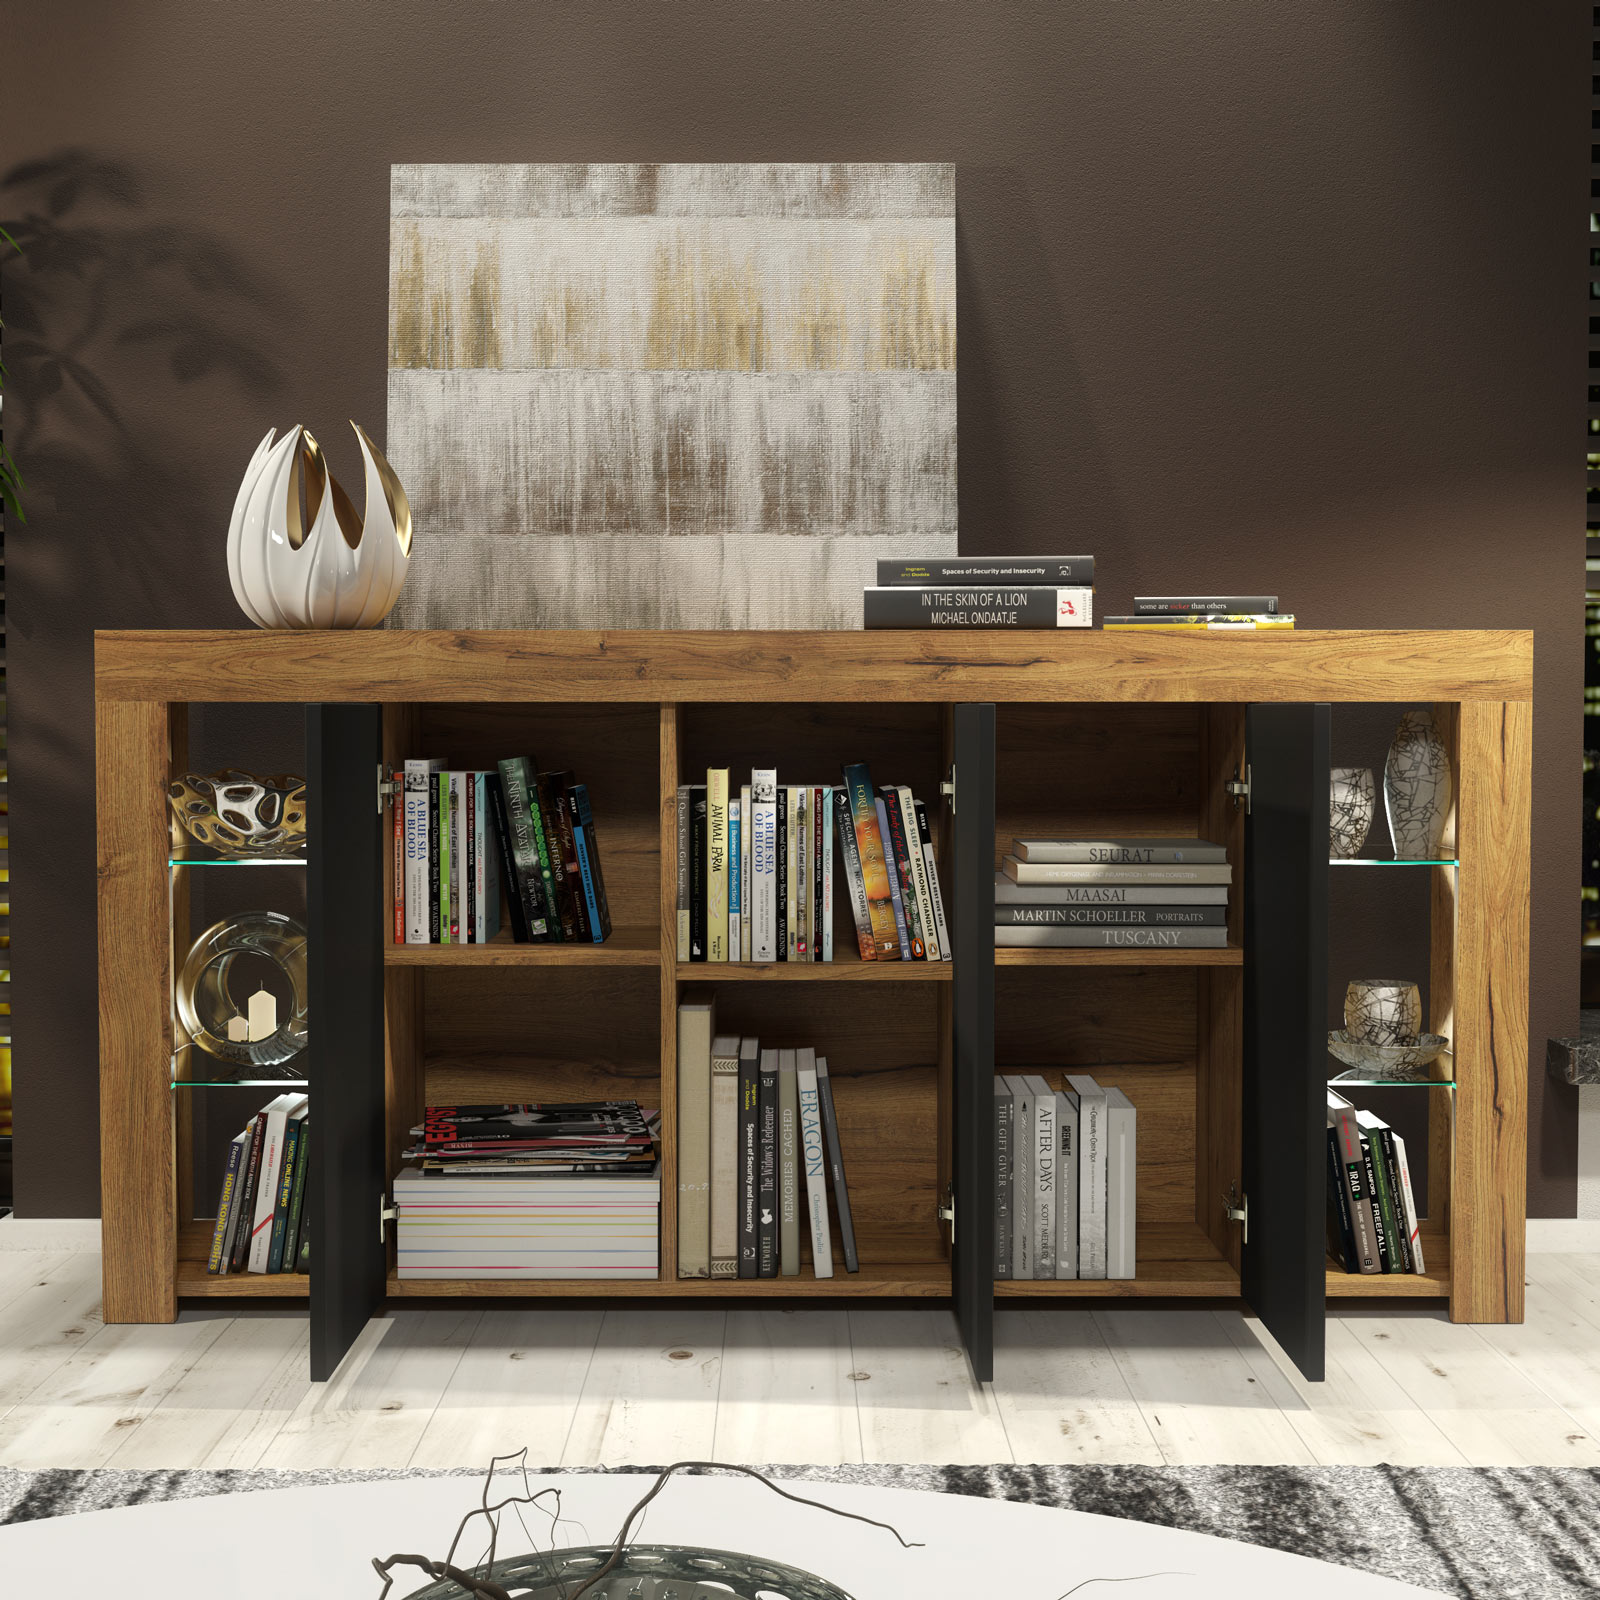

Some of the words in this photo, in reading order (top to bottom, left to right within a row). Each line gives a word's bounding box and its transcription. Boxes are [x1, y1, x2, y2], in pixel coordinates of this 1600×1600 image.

[972, 568, 999, 576] Security
[1013, 567, 1046, 576] Insecurity
[921, 594, 932, 606] IN
[934, 593, 954, 606] THE
[955, 593, 978, 606] SKIN
[980, 593, 994, 606] OF
[995, 593, 1003, 605] A
[1005, 593, 1027, 606] LION
[1169, 602, 1190, 610] sicker
[1191, 601, 1205, 609] than
[1206, 601, 1227, 609] others
[931, 612, 969, 624] MICHAEL
[971, 611, 1017, 624] ONDAATJE
[407, 801, 416, 818] OF
[417, 799, 426, 807] A
[507, 780, 524, 819] NINTH
[855, 784, 869, 821] FORTIFY
[887, 793, 897, 808] The
[417, 810, 426, 839] BLUE
[677, 802, 687, 826] Quaker
[711, 804, 724, 843] ANIMAL
[754, 813, 764, 830] OF
[889, 810, 899, 829] Lady
[407, 819, 416, 859] BLOOD
[679, 828, 687, 850] School
[764, 822, 774, 849] BLUE
[843, 812, 854, 843] SPECIAL
[861, 825, 875, 852] YOUR
[892, 831, 901, 839] of
[910, 827, 918, 848] SLEEP
[417, 840, 426, 861] SEA
[515, 823, 534, 866] AVATAR
[754, 831, 764, 873] BLOOD
[849, 844, 859, 868] AGENT
[894, 840, 903, 852] the
[1089, 848, 1155, 863] SEURAT
[550, 837, 564, 882] INFERNO
[679, 851, 687, 866] Girl
[711, 846, 724, 872] FARM
[764, 852, 774, 875] SEA
[868, 854, 880, 878] SOUL
[677, 867, 687, 896] Samplers
[853, 870, 863, 889] NICK
[928, 860, 937, 885] DENVER'S
[857, 890, 868, 918] TORRES
[914, 858, 926, 896] RAYMOND
[922, 898, 934, 937] CHANDLER
[1065, 888, 1126, 902] MAASAI
[876, 900, 890, 930] BERGEY
[1012, 909, 1066, 922] MARTIN
[1069, 909, 1146, 923] SCHOELLER
[1156, 912, 1204, 922] PORTRAITS
[1102, 930, 1181, 945] TUSCANY
[425, 1106, 457, 1143] EGOIST
[762, 1105, 774, 1144] Redeemer
[998, 1104, 1007, 1125] THE
[746, 1123, 755, 1147] Spaces
[783, 1108, 793, 1156] CACHED
[800, 1088, 824, 1177] ERAGON
[998, 1128, 1007, 1152] GIFT
[1040, 1108, 1052, 1153] AFTER
[1061, 1125, 1071, 1149] GREENING
[229, 1145, 240, 1169] Reese
[286, 1139, 295, 1163] MAKING
[747, 1147, 755, 1155] of
[762, 1146, 774, 1176] Widow's
[282, 1163, 292, 1189] ONLINE
[746, 1156, 754, 1184] Security
[998, 1154, 1007, 1187] GIVER
[1040, 1158, 1052, 1192] DAYS
[1348, 1170, 1361, 1192] IRAQ
[1367, 1169, 1377, 1195] SANFORD
[222, 1173, 234, 1202] HONG
[762, 1177, 774, 1192] The
[783, 1161, 794, 1223] MEMORIES
[1390, 1175, 1398, 1192] Chance
[1394, 1207, 1402, 1219] Book
[280, 1189, 288, 1208] NEWS
[217, 1203, 229, 1232] KONG
[745, 1198, 754, 1233] Insecurity
[812, 1194, 823, 1231] Christopher
[1041, 1203, 1049, 1227] SCOTT
[1372, 1202, 1387, 1255] FREEFALL
[210, 1234, 223, 1271] NIGHTS
[762, 1236, 771, 1272] KEYWORTH
[816, 1232, 825, 1254] Paolini
[1041, 1228, 1049, 1261] MEDBURY
[1360, 1230, 1369, 1255] WITHDRAWAL
[1400, 1238, 1410, 1269] BEGINNINGS
